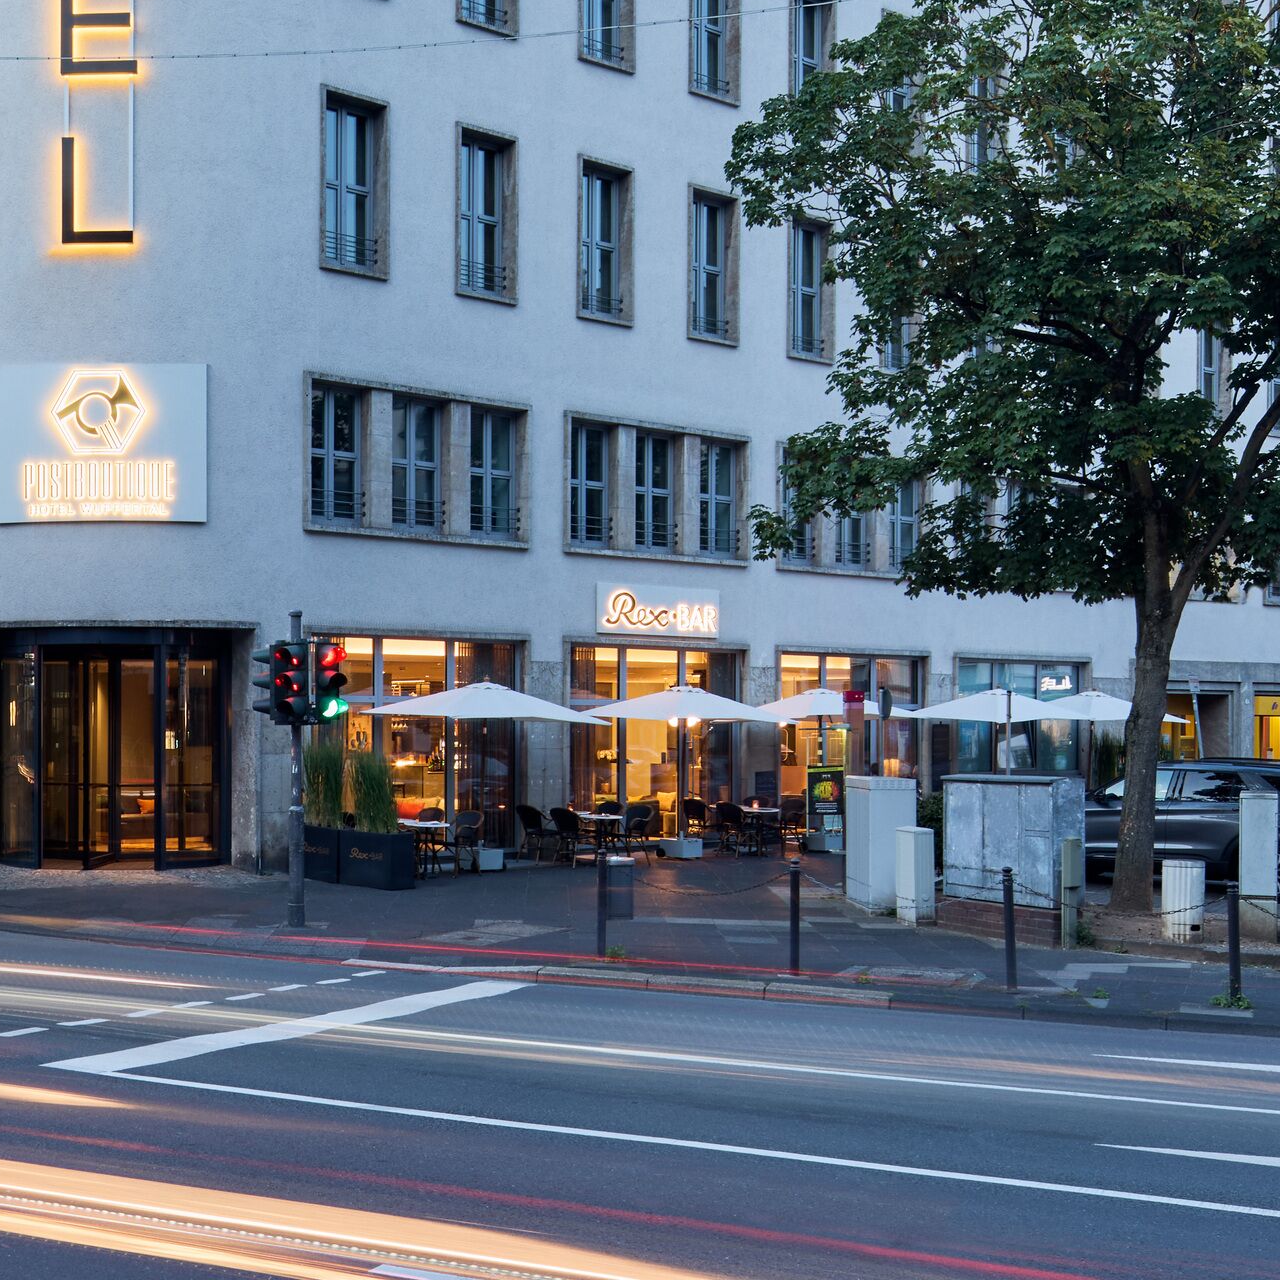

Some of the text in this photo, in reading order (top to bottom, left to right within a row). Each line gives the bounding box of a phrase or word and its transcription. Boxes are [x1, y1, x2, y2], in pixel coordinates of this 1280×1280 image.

[23, 462, 176, 500] POSTBOUTIQUE
[30, 503, 169, 516] HOTEL WUPPERTAL
[605, 591, 718, 632] Rex BAR
